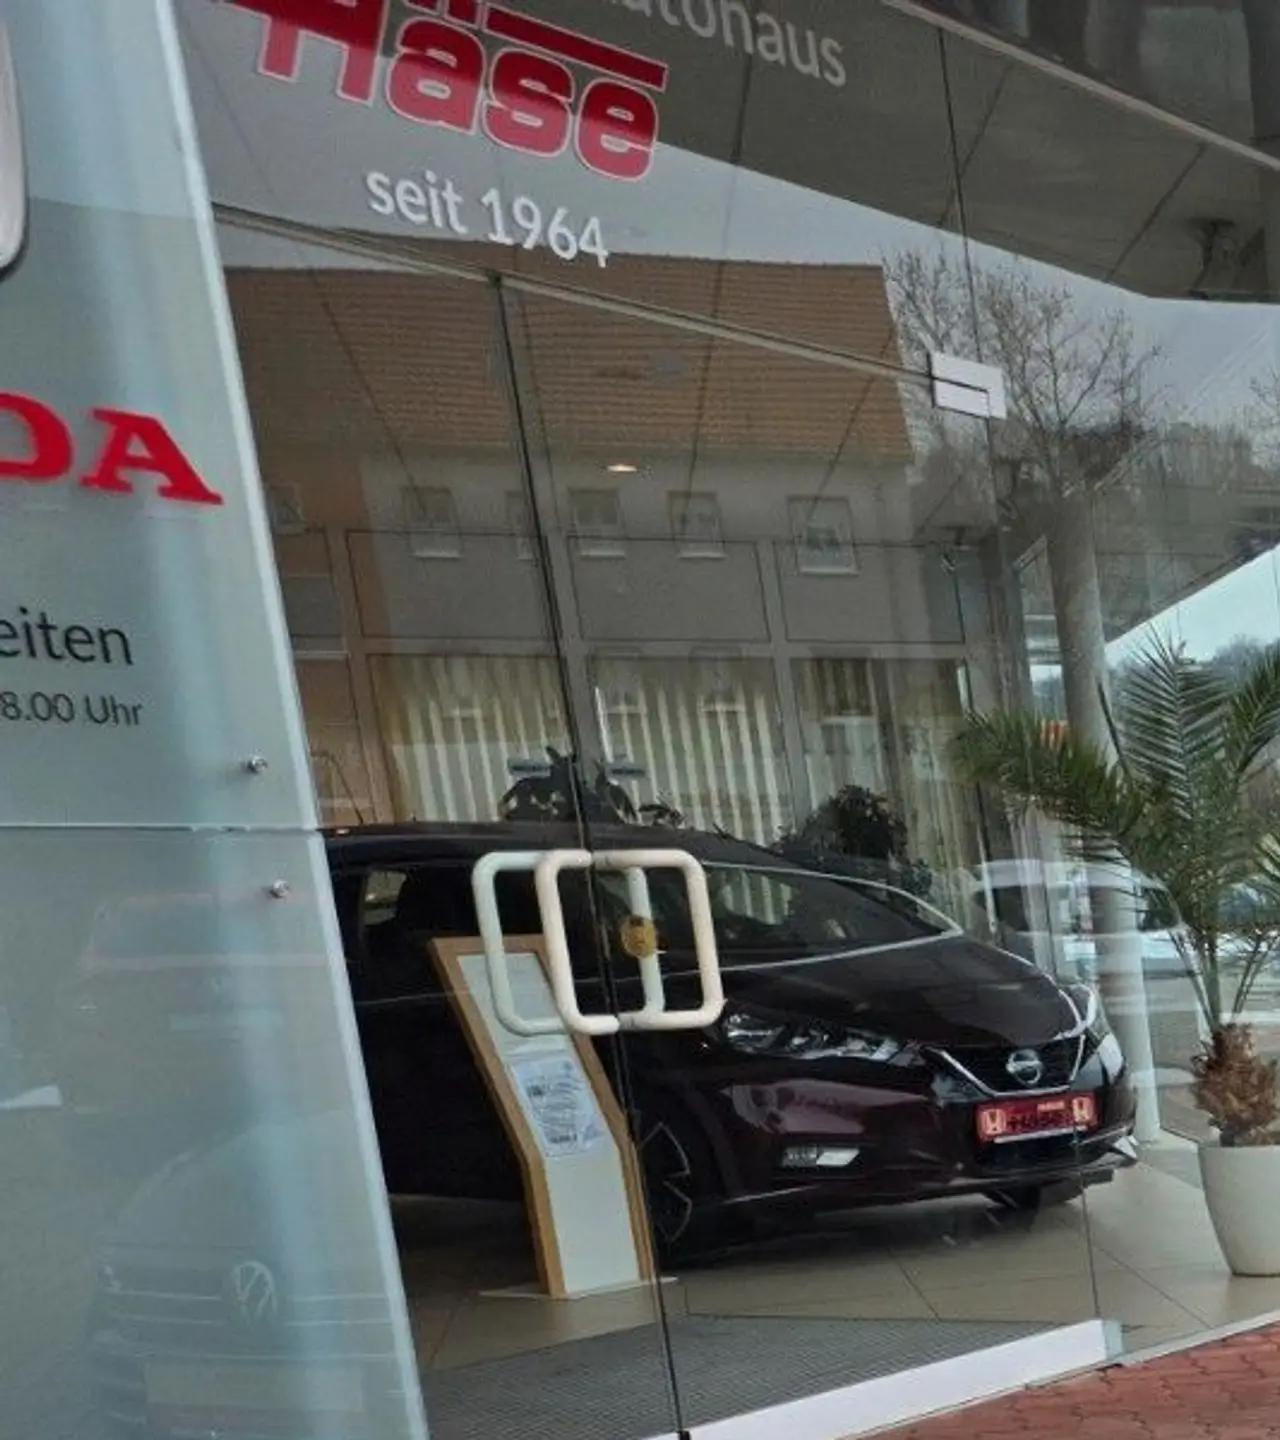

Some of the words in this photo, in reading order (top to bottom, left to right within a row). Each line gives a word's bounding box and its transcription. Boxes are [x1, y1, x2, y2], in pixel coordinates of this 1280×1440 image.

[369, 170, 468, 235] seit
[480, 187, 609, 269] 1964
[0, 392, 224, 505] DA
[0, 606, 134, 665] eiten
[0, 691, 75, 723] 8.00
[84, 694, 143, 726] Uhr
